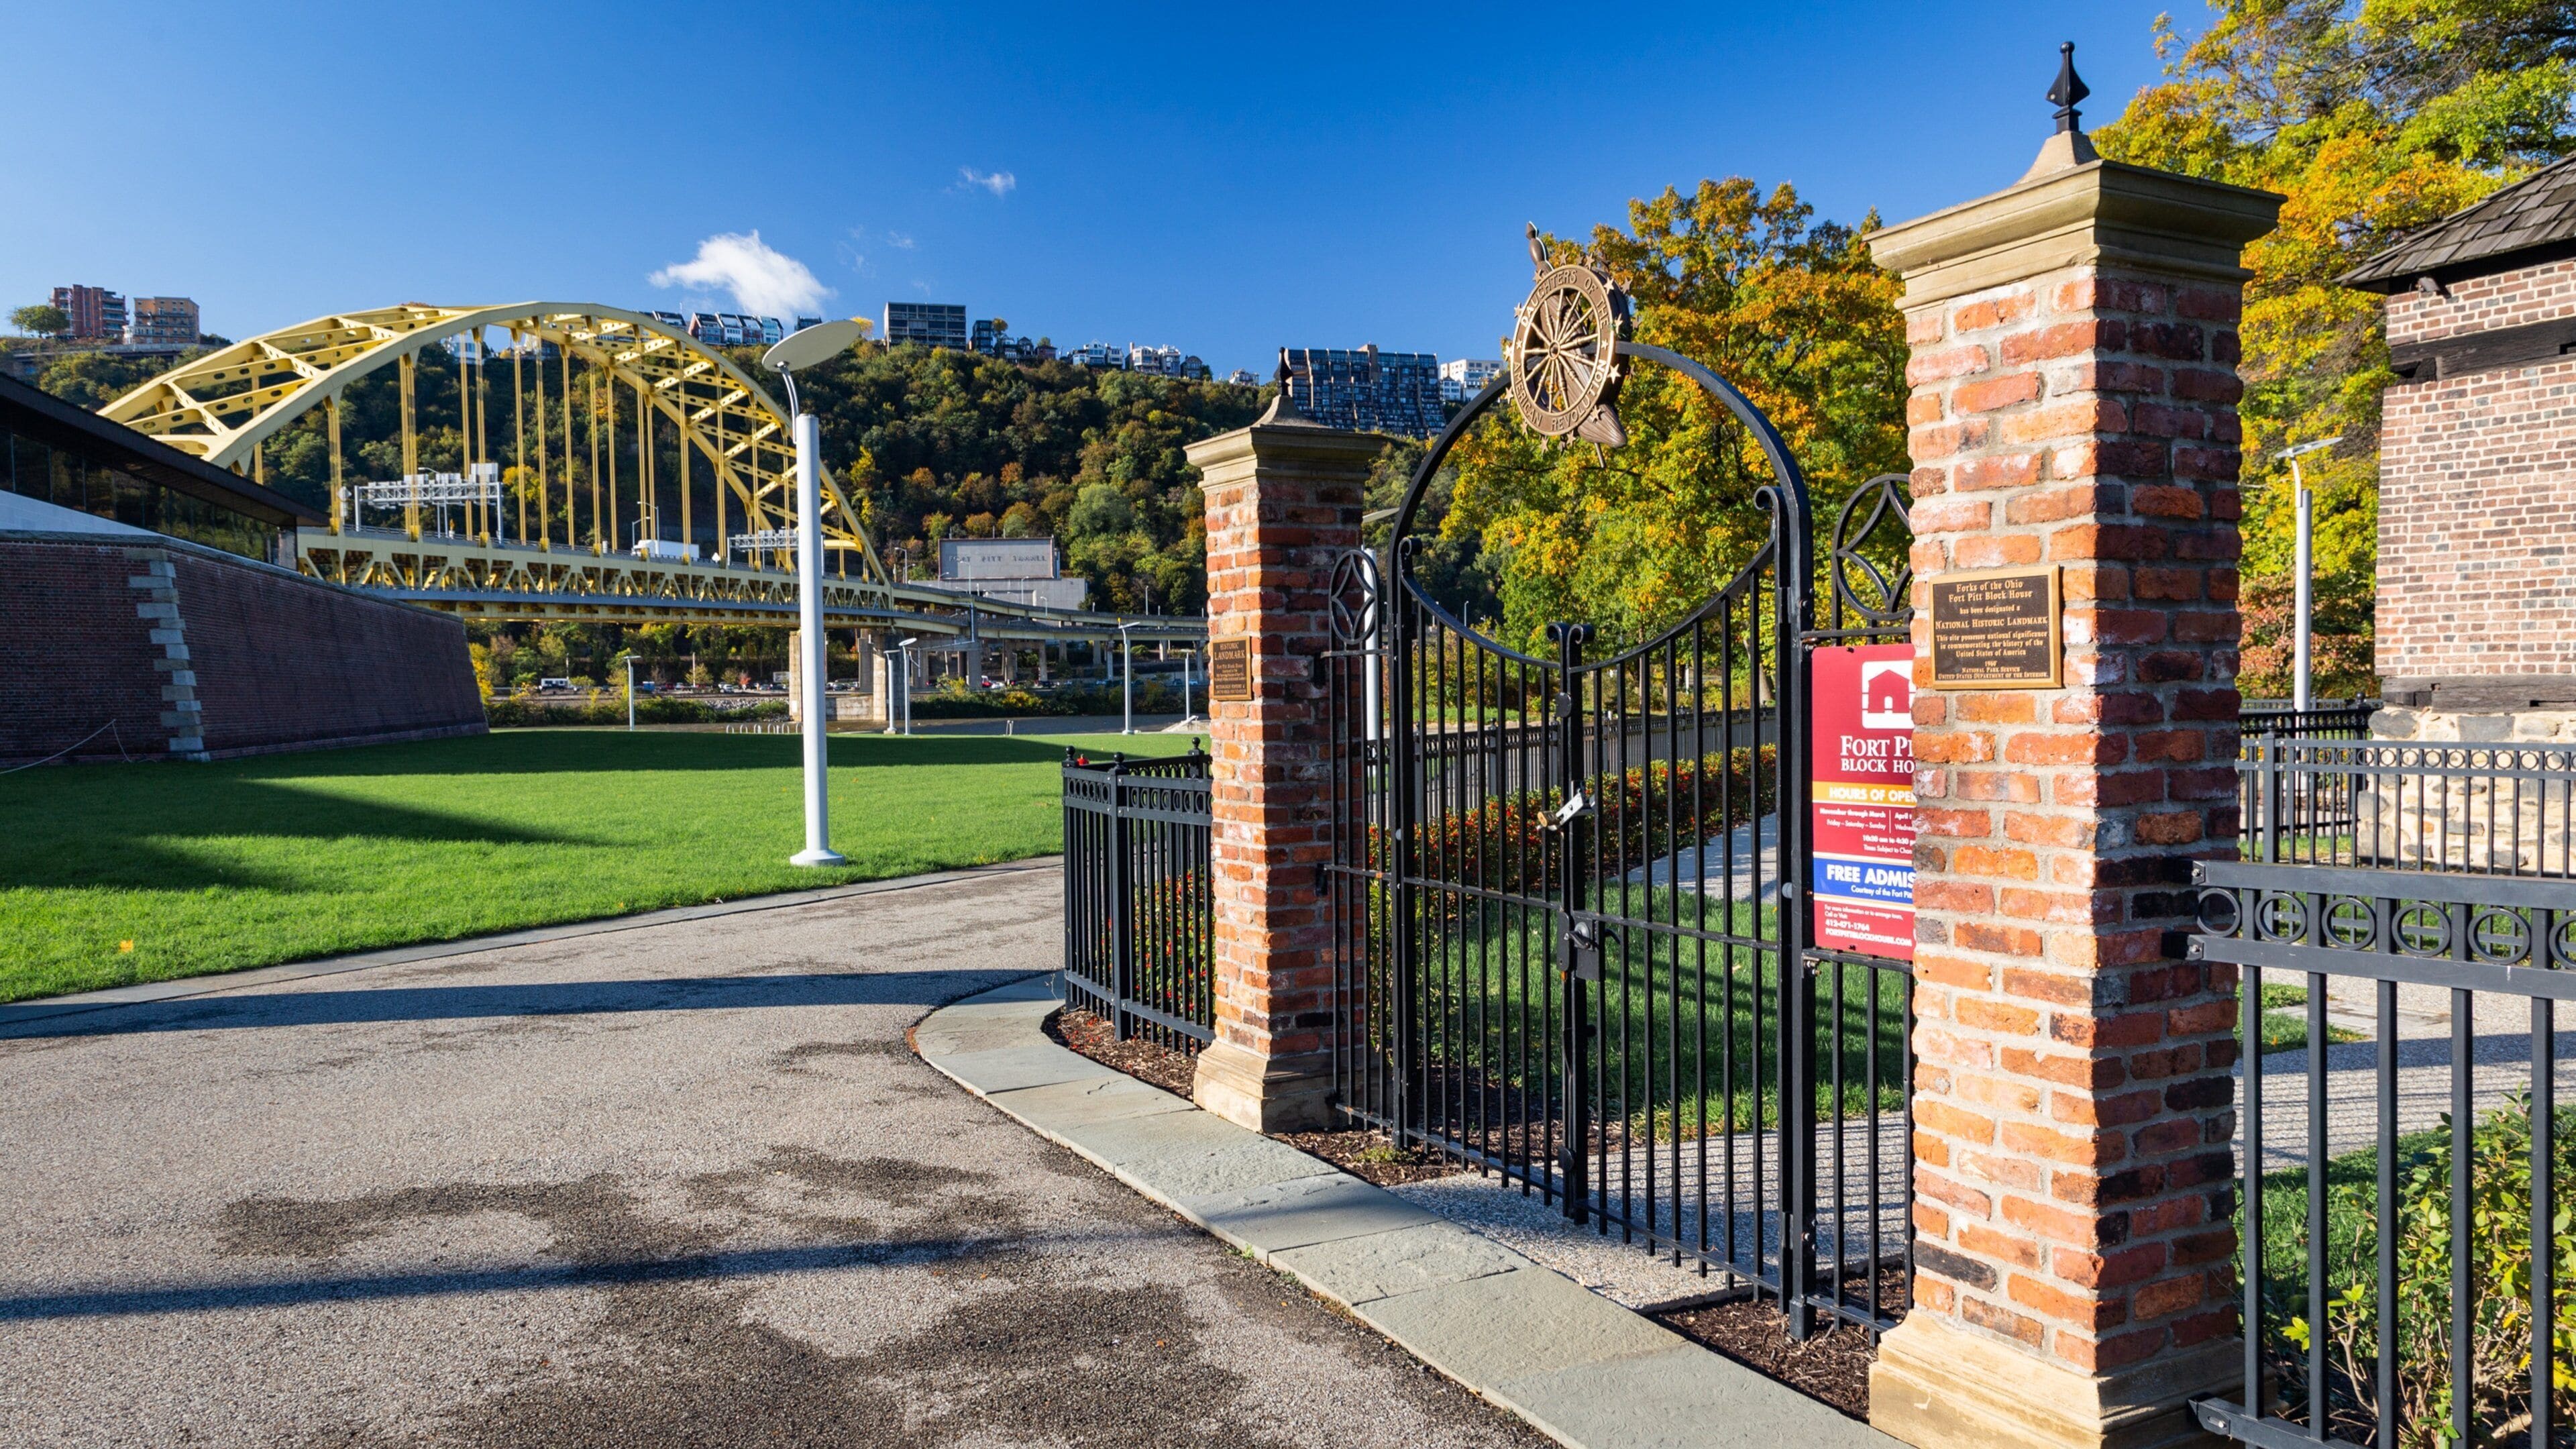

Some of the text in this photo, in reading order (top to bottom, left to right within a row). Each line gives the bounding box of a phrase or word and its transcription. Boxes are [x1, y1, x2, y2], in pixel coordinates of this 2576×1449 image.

[1521, 270, 1610, 329] DAUGHTERS OF THE
[1514, 359, 1607, 431] AMERICAN REVOLUTION
[1956, 580, 2023, 592] Forks of the Ohio
[1949, 590, 2033, 602] Fort Pitt Block House
[1985, 604, 2015, 614] designated
[1935, 616, 2048, 629] NATIONAL HISTORIC LANDMARK
[1987, 631, 2011, 639] national
[2013, 631, 2047, 639] significance
[1220, 642, 1239, 650] HISTORIC
[1947, 641, 1990, 649] commemorating
[2002, 639, 2023, 648] history
[1214, 649, 1245, 661] LANDMARK
[1840, 735, 1913, 757] FORT PI
[1841, 758, 1887, 772] BLOCK
[1829, 787, 1867, 800] HOURS
[1870, 789, 1886, 801] OF
[1894, 812, 1909, 820] April
[1827, 864, 1917, 889] FREE ADMIS
[1851, 885, 1874, 896] Courtesy
[1882, 888, 1890, 896] the
[1892, 890, 1902, 898] Fort
